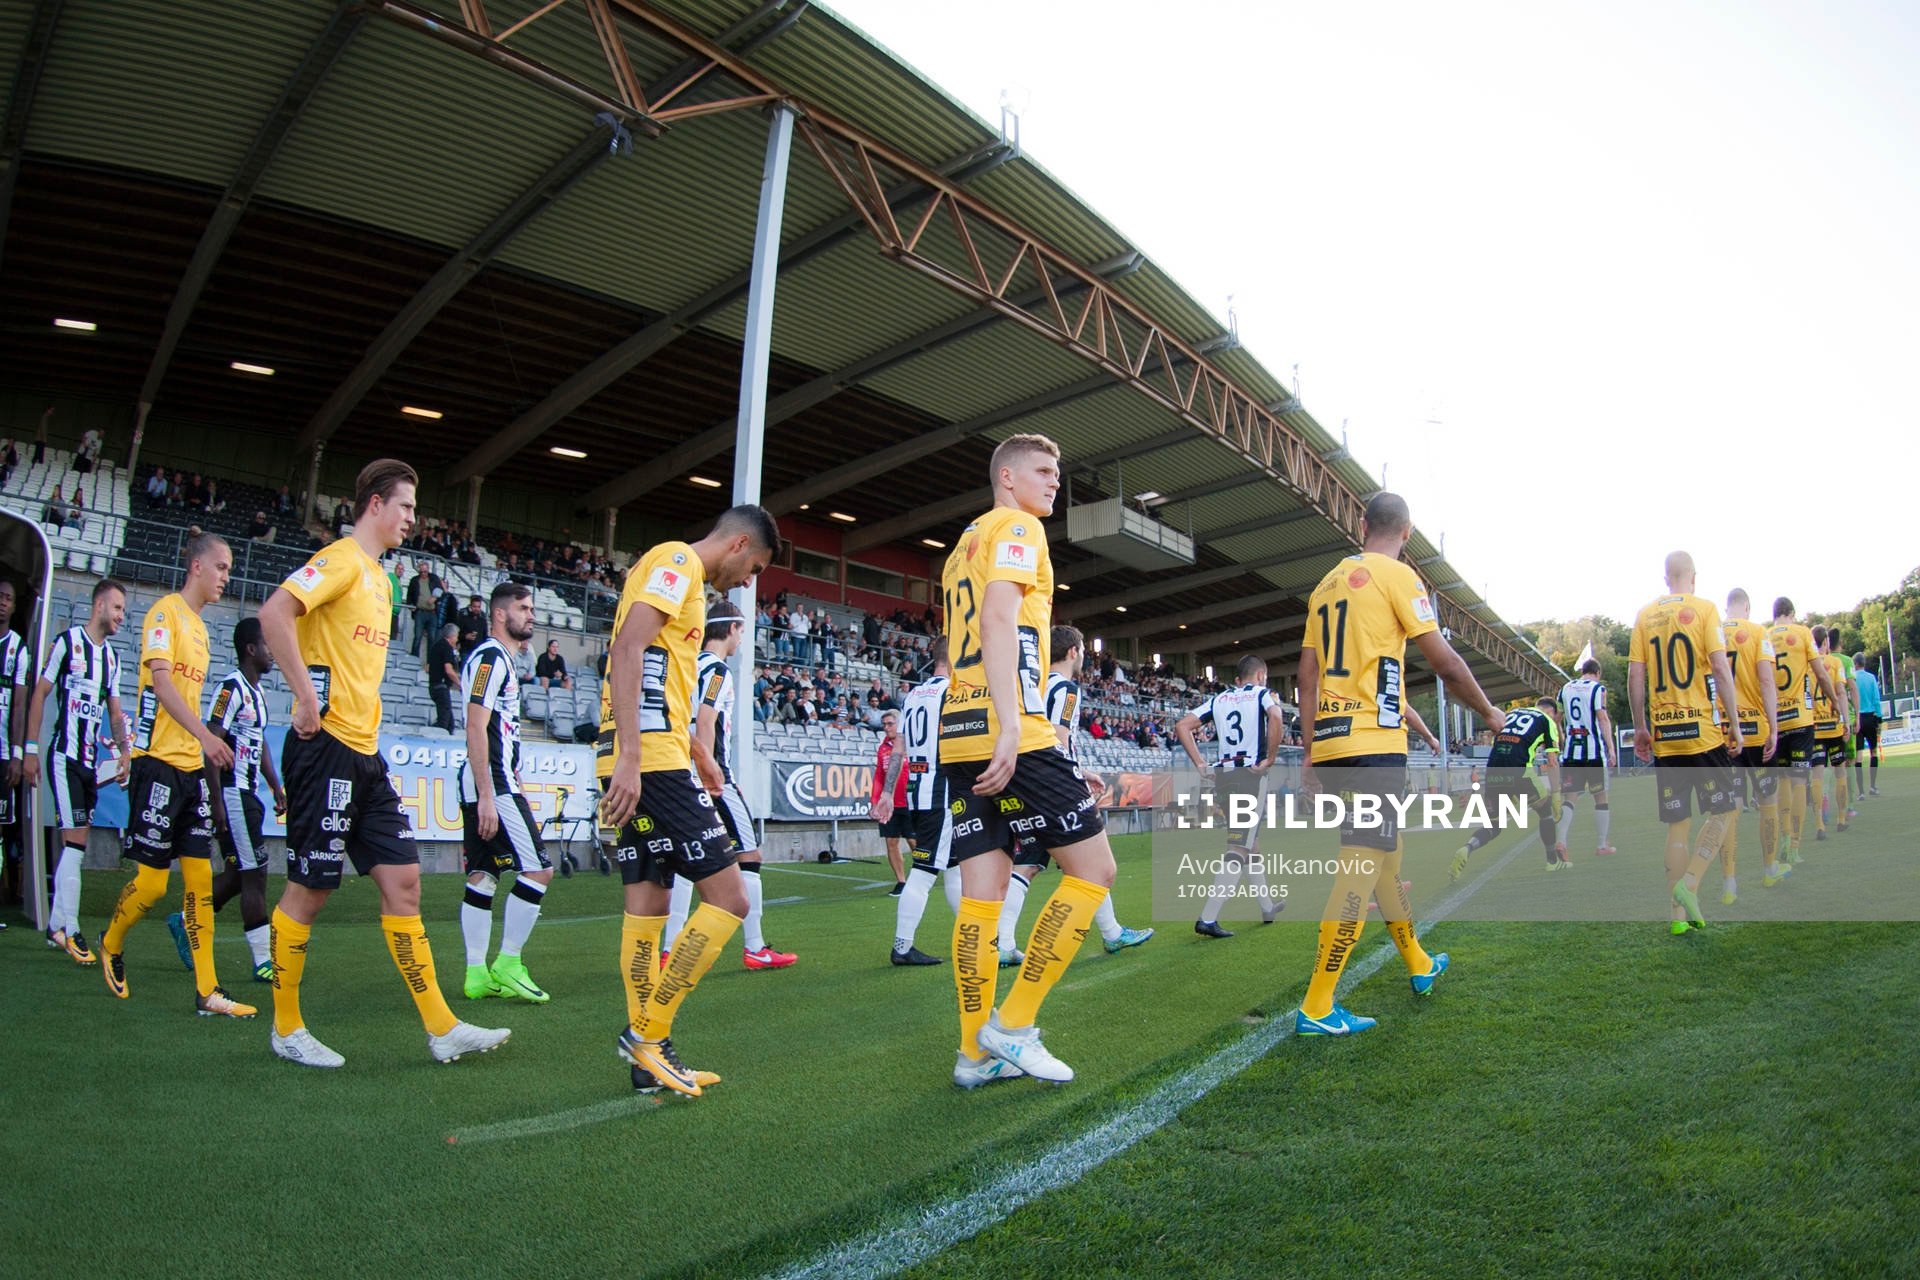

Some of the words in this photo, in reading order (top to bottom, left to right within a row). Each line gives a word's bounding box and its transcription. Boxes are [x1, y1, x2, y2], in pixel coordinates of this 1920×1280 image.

[945, 576, 983, 670] 12
[1317, 598, 1351, 678] 11
[1650, 632, 1695, 693] 10
[1775, 652, 1792, 691] 5
[905, 705, 928, 747] 10
[1226, 710, 1243, 746] 3
[1500, 713, 1534, 736] 29
[1570, 697, 1581, 721] 6
[142, 807, 171, 828] ellos
[321, 812, 352, 832] ellos
[1058, 811, 1083, 832] 12
[682, 840, 705, 862] 13
[1023, 899, 1073, 983] SPRINGYARD
[1325, 891, 1361, 973] SPRINGYARD
[654, 928, 710, 1006] SPRINGYARD
[957, 923, 990, 1013] SPRINGYARD
